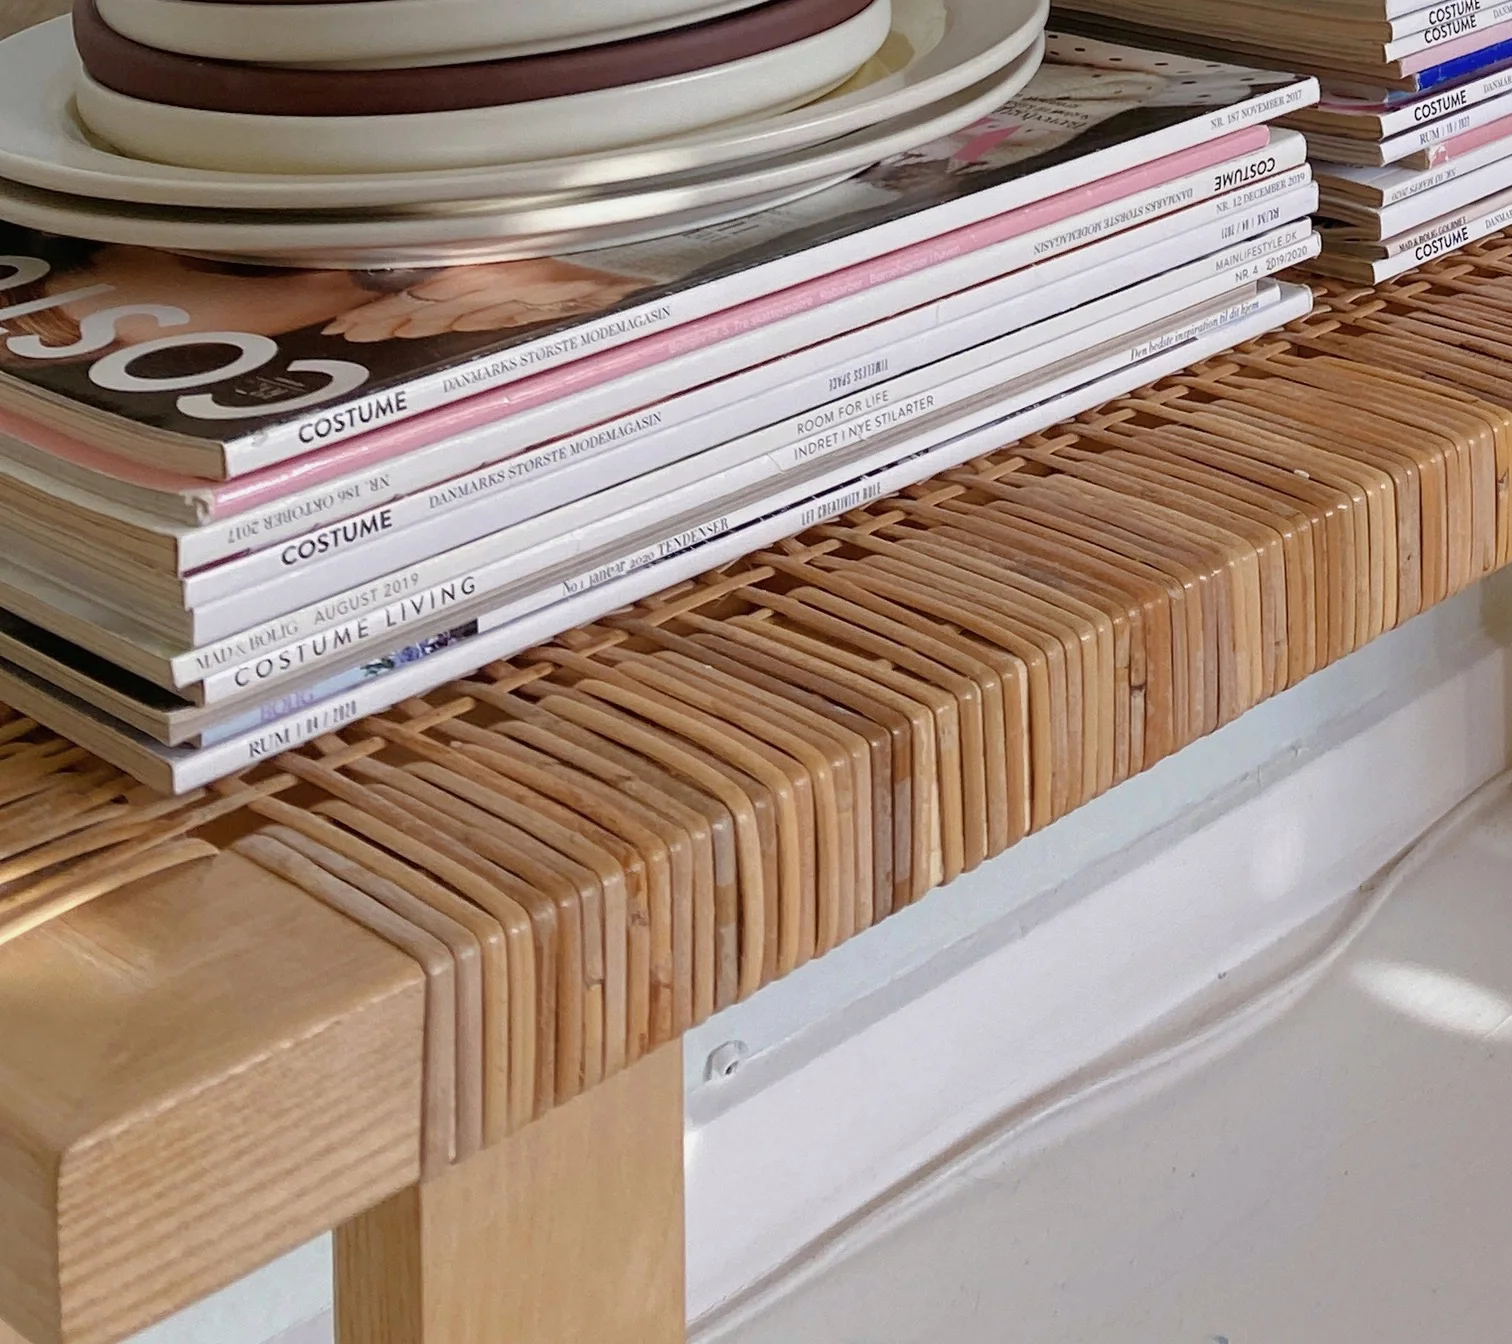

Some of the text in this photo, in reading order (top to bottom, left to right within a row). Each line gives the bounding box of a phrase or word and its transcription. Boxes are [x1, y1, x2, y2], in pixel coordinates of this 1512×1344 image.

[1424, 14, 1477, 44] COSTUME
[1210, 89, 1303, 130] NR. 187 NOVEMBER 2017
[1414, 90, 1467, 122] COSTUME
[1419, 129, 1440, 145] RUM
[1214, 157, 1276, 191] COSTUME
[1144, 188, 1193, 218] DANMARKS
[1215, 201, 1231, 213] NR.
[1243, 180, 1285, 205] DECEMBER
[1286, 172, 1307, 189] 2019
[1256, 207, 1280, 226] RUM
[1033, 219, 1102, 256] MODEMAGASIN
[1215, 230, 1298, 272] MAINLIFESTYLE.DK
[1415, 227, 1469, 261] COSTUME
[1265, 245, 1308, 271] 2019/2020
[1130, 300, 1259, 362] Den bedste inspiration til dit hjem
[298, 391, 408, 443] COSTUME
[442, 359, 517, 393] DANMARKS
[580, 306, 672, 348] MODEMAGASIN
[794, 432, 838, 461] INDRET
[849, 419, 872, 439] NYE
[874, 395, 935, 428] STILARTER
[797, 390, 890, 436] ROOM FOR LIFE
[280, 509, 393, 566] COSTUME
[427, 470, 505, 509] DANMARKS
[569, 411, 662, 455] MODEMAGASIN
[337, 485, 360, 502] 186
[264, 494, 334, 530] OKTOBER
[801, 508, 814, 526] LET
[817, 490, 860, 519] CREATIVITY
[227, 523, 260, 544] 2017
[629, 552, 654, 570] 2020
[656, 517, 729, 557] TENDENSER
[195, 646, 232, 673] MAD
[249, 618, 299, 651] BOLIG
[314, 588, 378, 625] AUGUST
[383, 572, 420, 598] 2019
[234, 576, 476, 687] COSTUME LIVING
[248, 728, 290, 759] RUM
